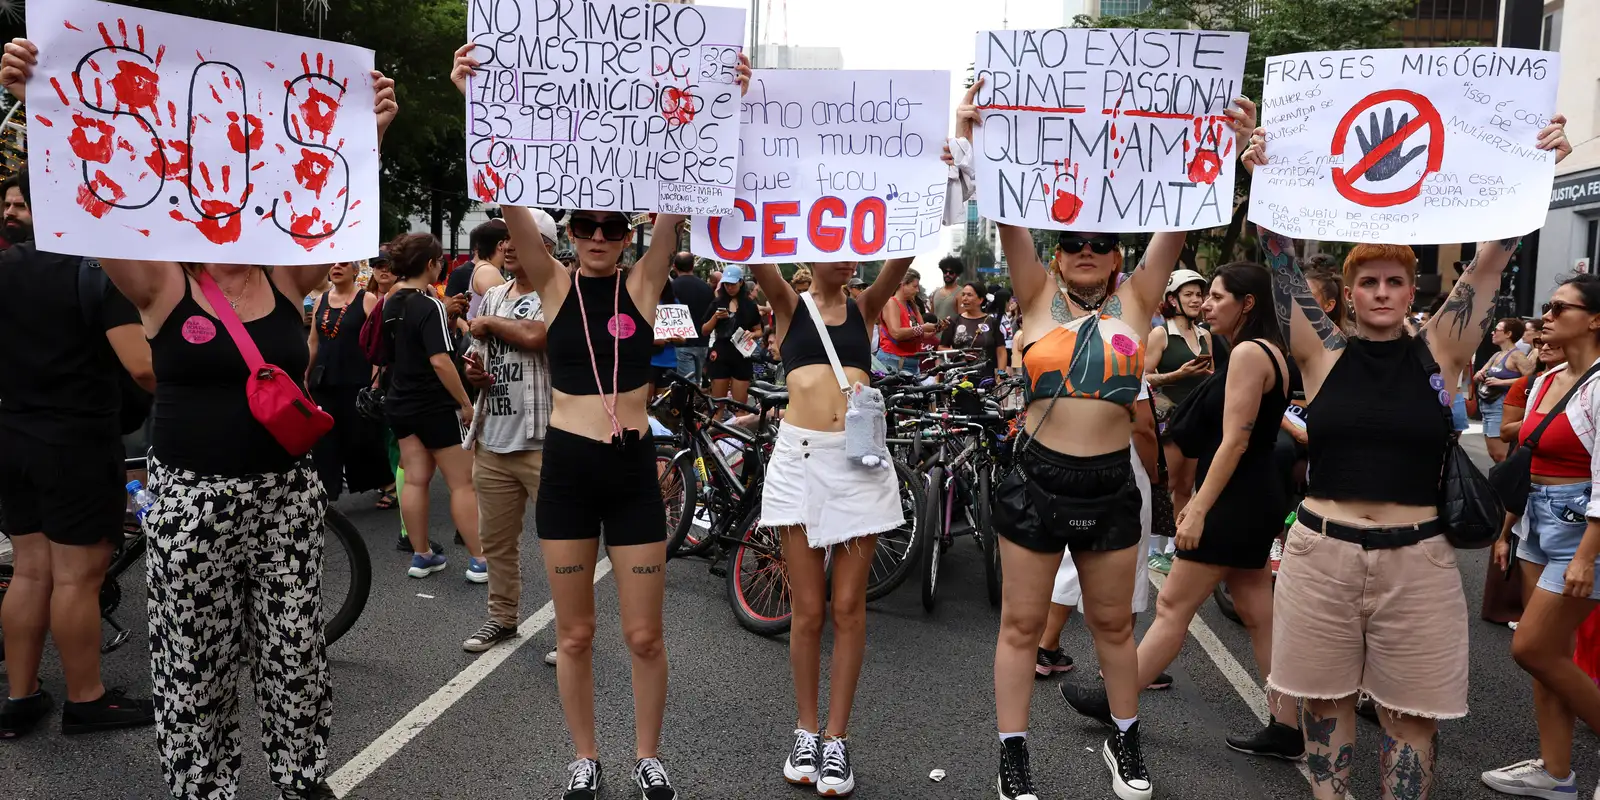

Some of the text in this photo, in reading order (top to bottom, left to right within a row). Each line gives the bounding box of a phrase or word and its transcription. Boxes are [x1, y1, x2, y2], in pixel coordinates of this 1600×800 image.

[472, 0, 521, 34] NO
[704, 47, 738, 65] 20
[988, 29, 1068, 68] NÃO
[472, 68, 516, 103] 718
[701, 63, 735, 85] 25
[1266, 55, 1374, 85] FRASES
[812, 79, 923, 126] andado
[1305, 84, 1322, 98] SÓ
[470, 138, 580, 174] CONTRA
[762, 137, 800, 158] um
[818, 123, 923, 158] mundo
[983, 114, 1223, 176] QUEM AMA
[477, 170, 524, 203] NO
[697, 186, 723, 197] MAPA
[743, 163, 876, 204] que ficou
[999, 167, 1222, 227] NÃO MATA
[1421, 185, 1463, 196] ROUPA
[1550, 181, 1600, 202] JUSTIÇA FE
[887, 191, 920, 252] Billie
[919, 182, 947, 238] Eilish
[1370, 212, 1419, 223] CARGO?
[707, 195, 887, 262] CEGO
[1272, 219, 1302, 234] PARA
[1350, 221, 1390, 231] DADO
[655, 306, 690, 320] ROTEJAM
[655, 326, 696, 337] AMIGAS
[1069, 519, 1097, 527] GUESS
